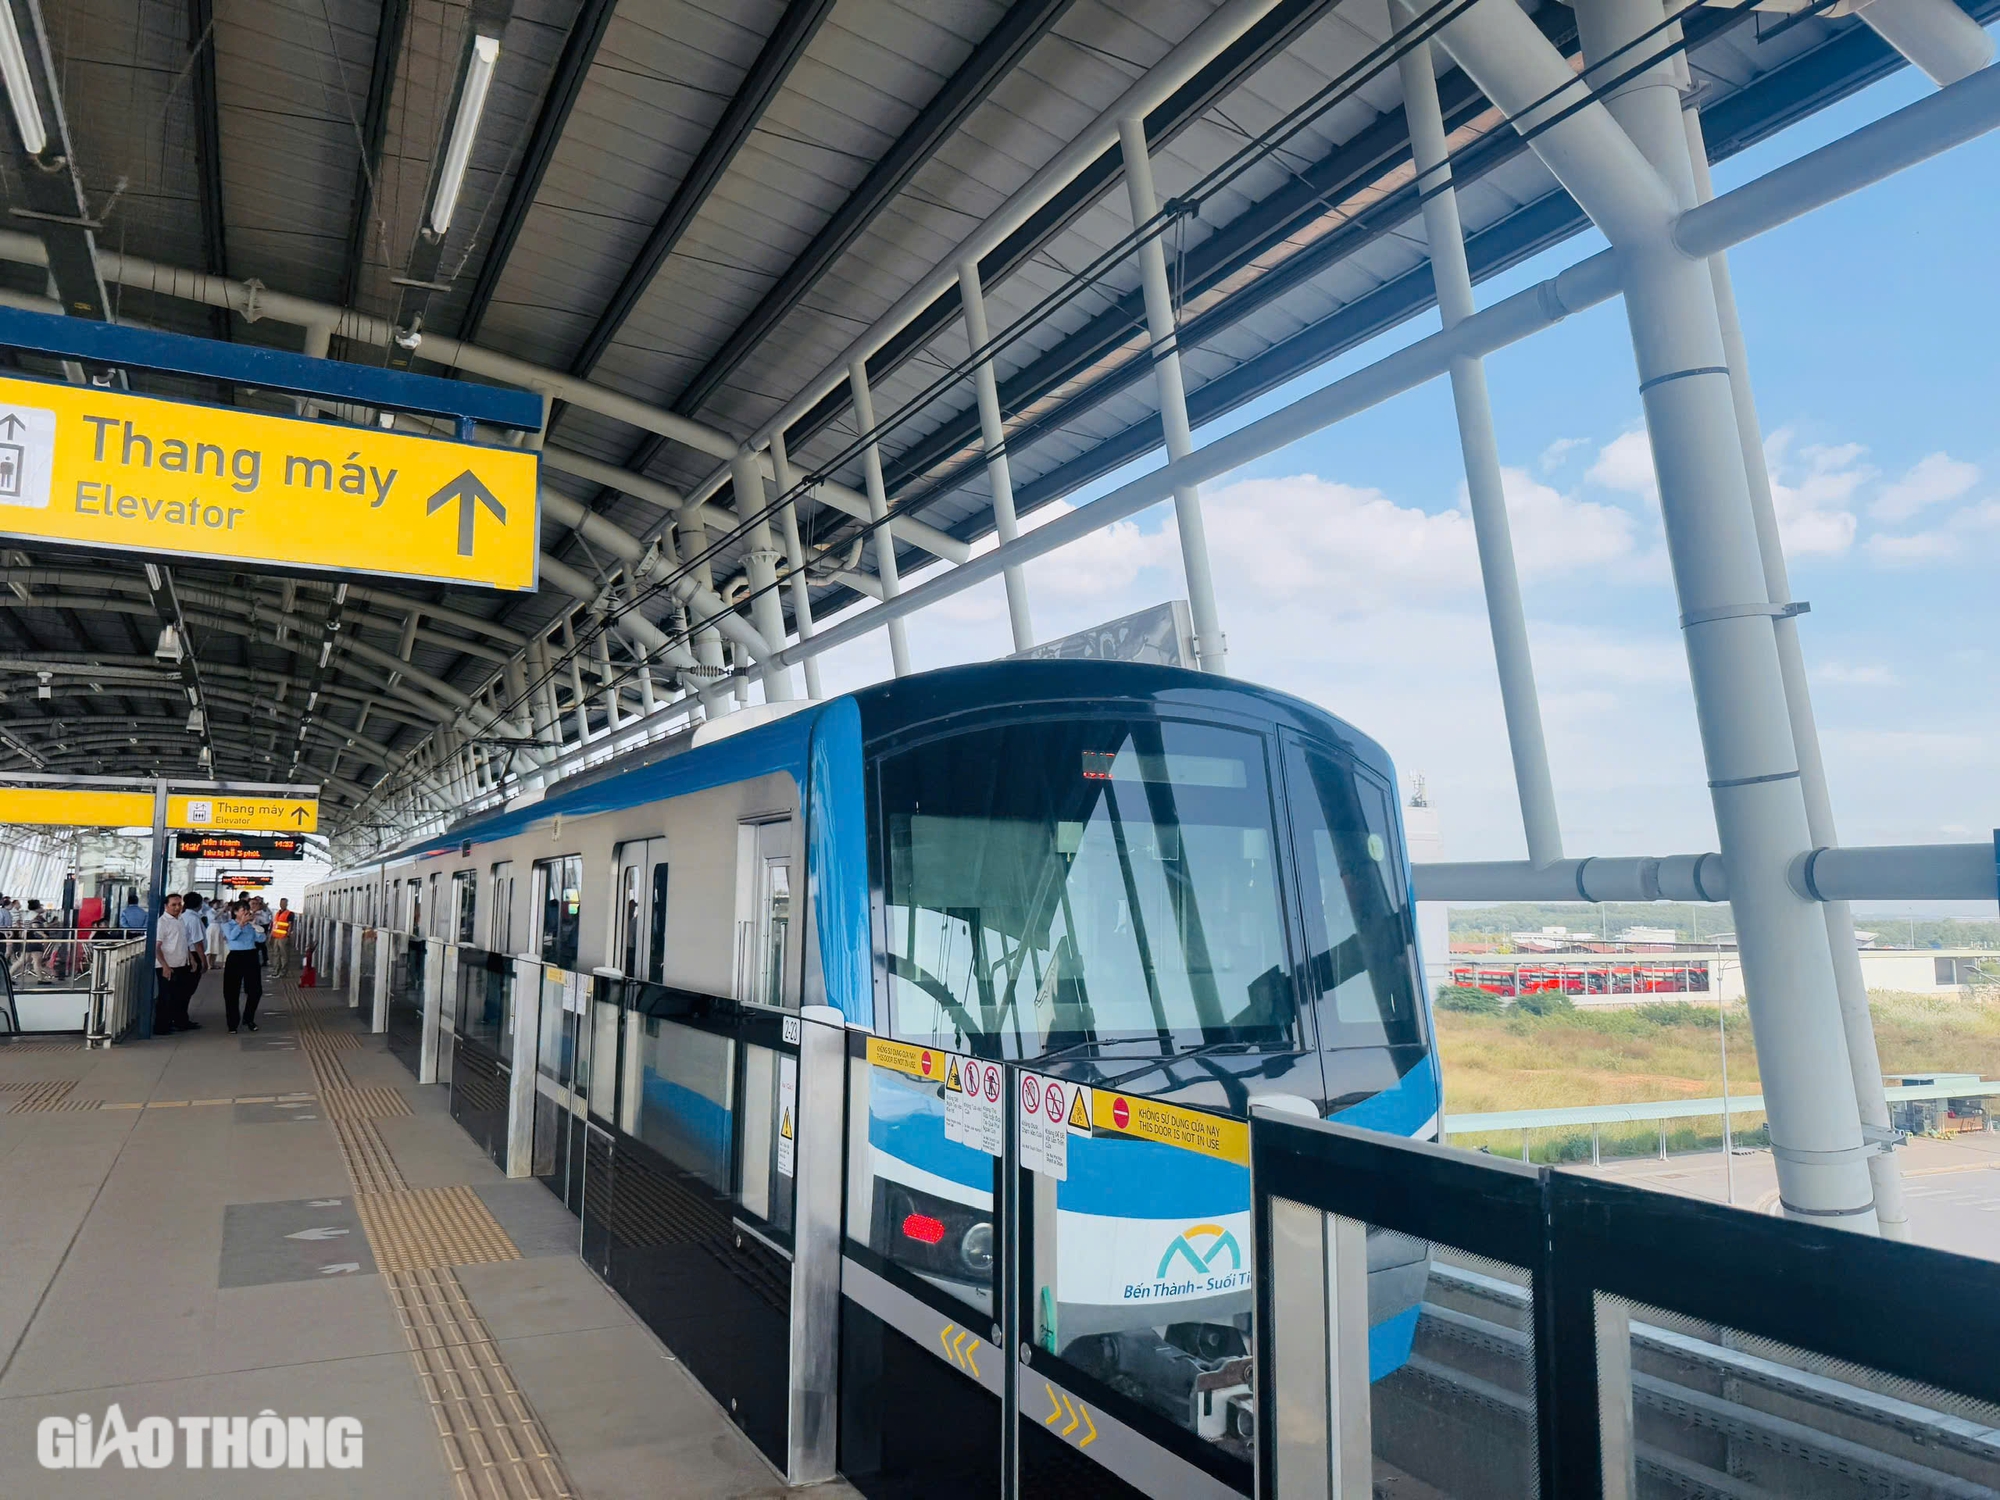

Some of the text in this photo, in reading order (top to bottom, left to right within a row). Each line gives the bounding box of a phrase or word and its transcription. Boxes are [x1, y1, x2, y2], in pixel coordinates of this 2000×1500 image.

[83, 414, 398, 508] Thang máy
[75, 480, 245, 531] Elevator
[215, 816, 250, 825] Elevator
[218, 802, 285, 817] Thang máy
[295, 843, 303, 855] 2
[1138, 1107, 1160, 1123] KHÔNG
[1139, 1120, 1220, 1150] THIS DOOR IS NOT IN USE
[1123, 1282, 1150, 1299] Bến
[1153, 1280, 1194, 1297] Thành
[1206, 1273, 1236, 1291] Suối
[1238, 1271, 1252, 1286] Ti
